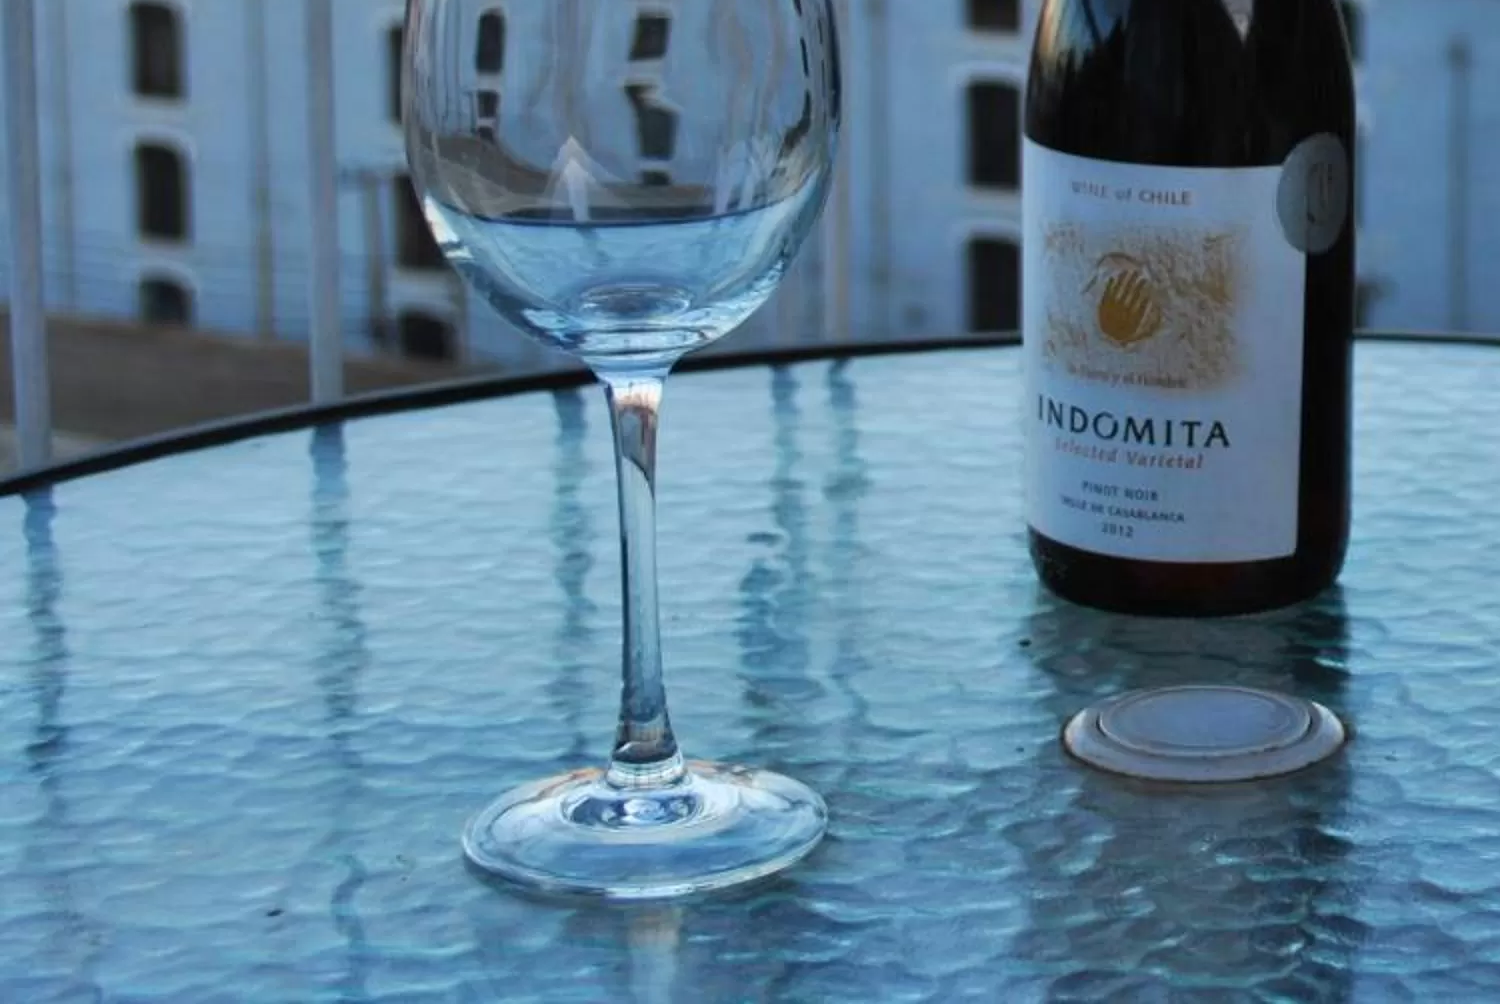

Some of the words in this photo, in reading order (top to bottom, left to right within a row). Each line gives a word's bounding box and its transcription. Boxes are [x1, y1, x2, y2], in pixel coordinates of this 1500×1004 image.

[1138, 189, 1193, 206] CHILE
[1038, 393, 1231, 448] INDOMITA
[1126, 451, 1204, 470] Varietal
[1082, 480, 1118, 497] PINOT
[1124, 487, 1159, 502] NOIR
[1108, 505, 1185, 523] CASABLANCA
[1101, 522, 1134, 538] 2012
